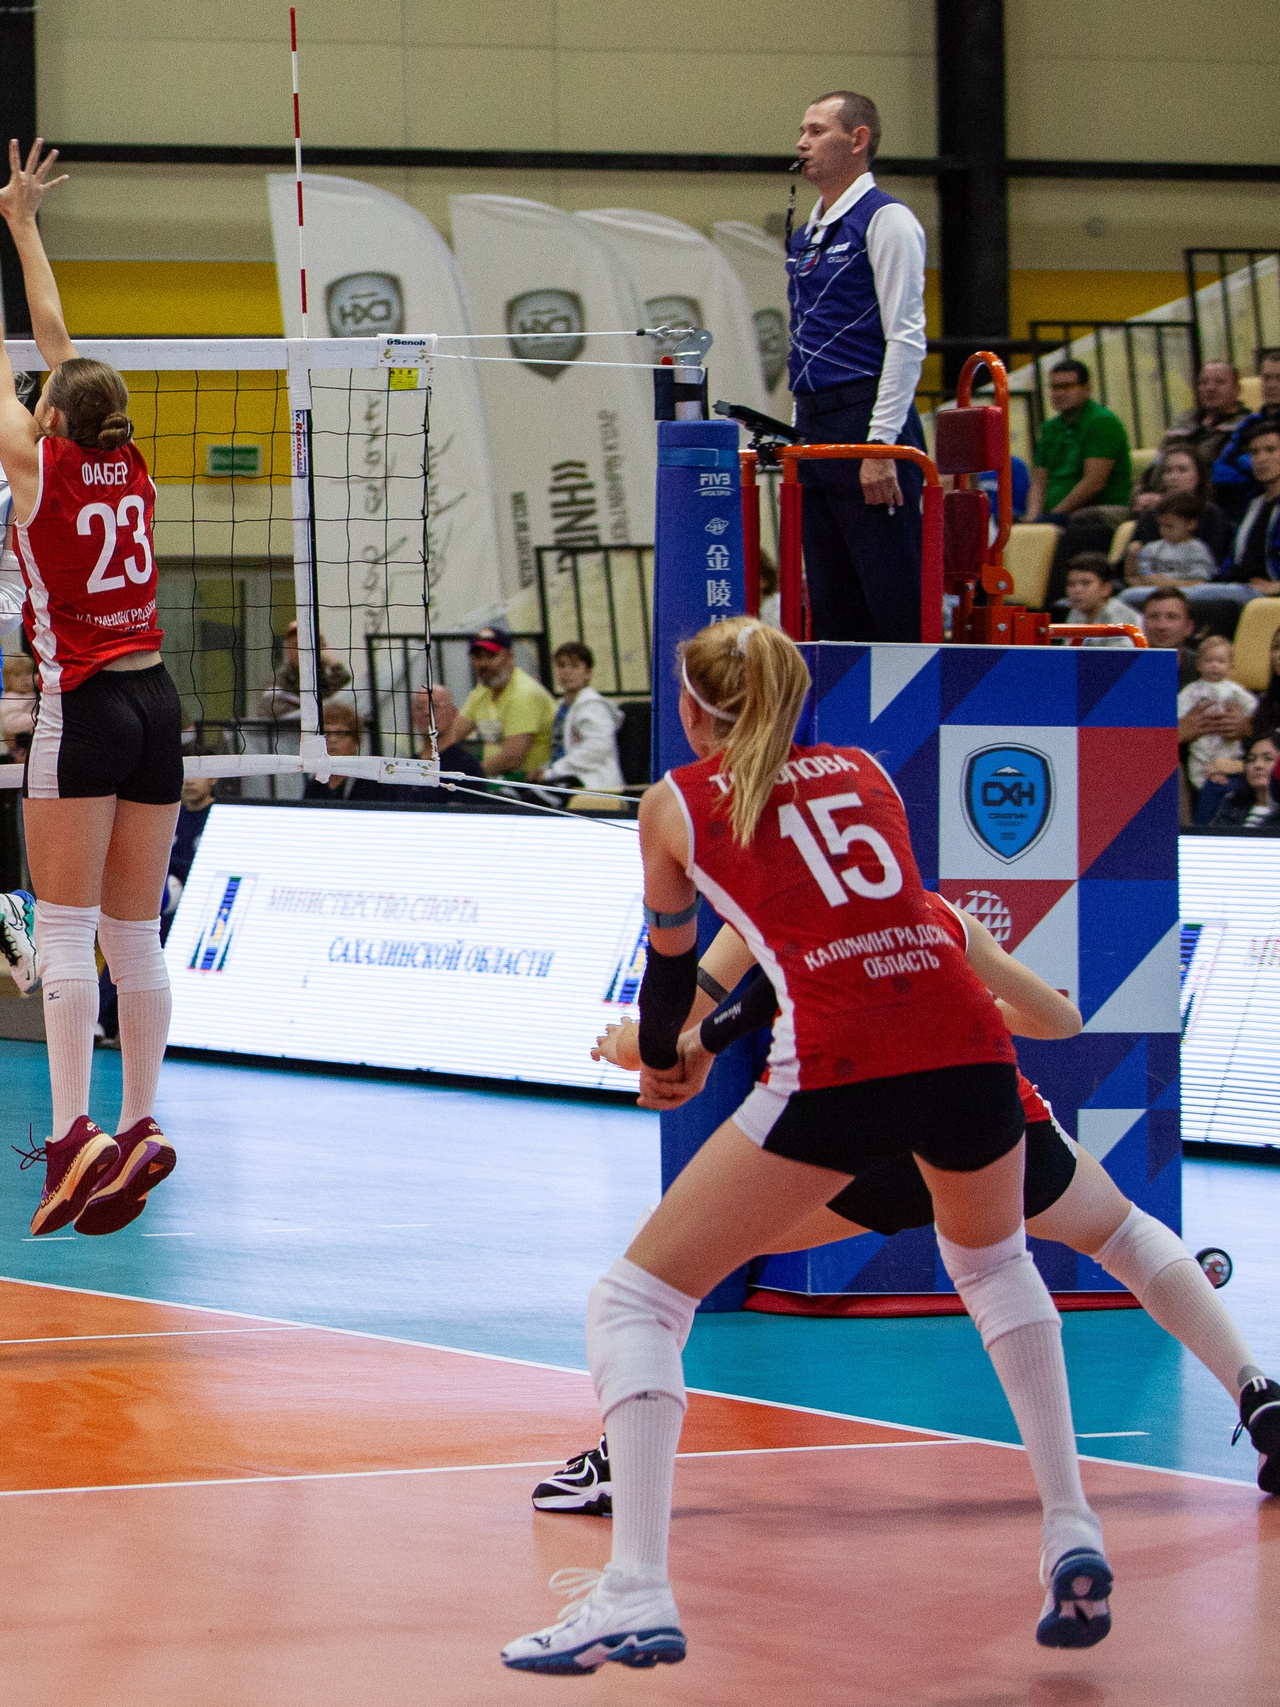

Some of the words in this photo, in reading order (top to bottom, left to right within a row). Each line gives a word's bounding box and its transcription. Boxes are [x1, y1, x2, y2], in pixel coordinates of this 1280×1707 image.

[393, 338, 426, 346] Senoh
[81, 461, 129, 486] ФАБЕР
[700, 473, 731, 486] FIVB
[76, 494, 153, 595] 23
[708, 754, 860, 796] ТПОВА
[777, 792, 904, 908] 15
[327, 935, 465, 972] САХАЛИНСКОЙ
[465, 944, 556, 979] ОБЛАСТИ
[862, 949, 941, 980] ОБЛАСТЬ
